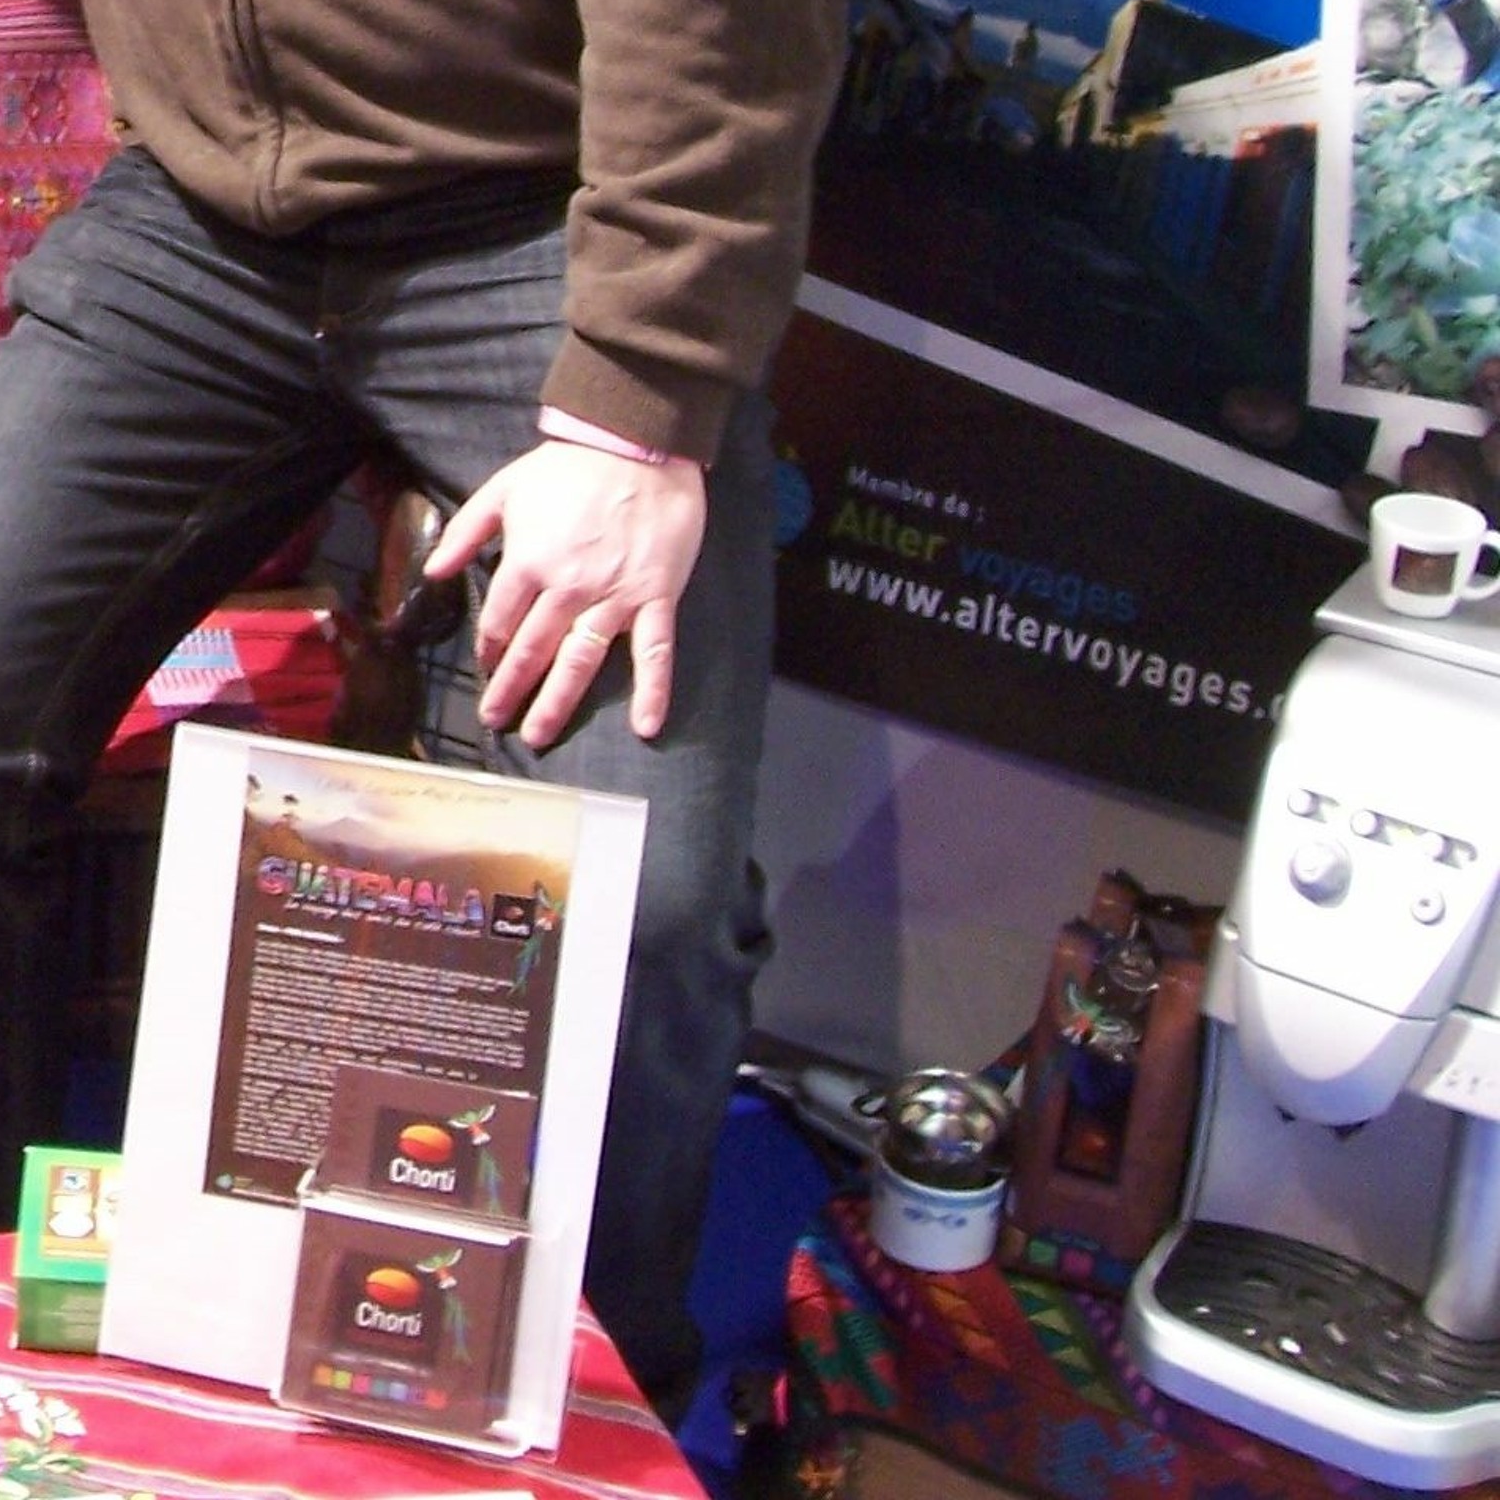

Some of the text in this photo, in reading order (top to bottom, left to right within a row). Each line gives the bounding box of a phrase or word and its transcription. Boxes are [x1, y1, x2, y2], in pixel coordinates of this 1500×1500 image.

[830, 501, 1138, 622] Alter voyages
[389, 1156, 457, 1193] Chorti
[354, 1299, 423, 1337] Chorti
